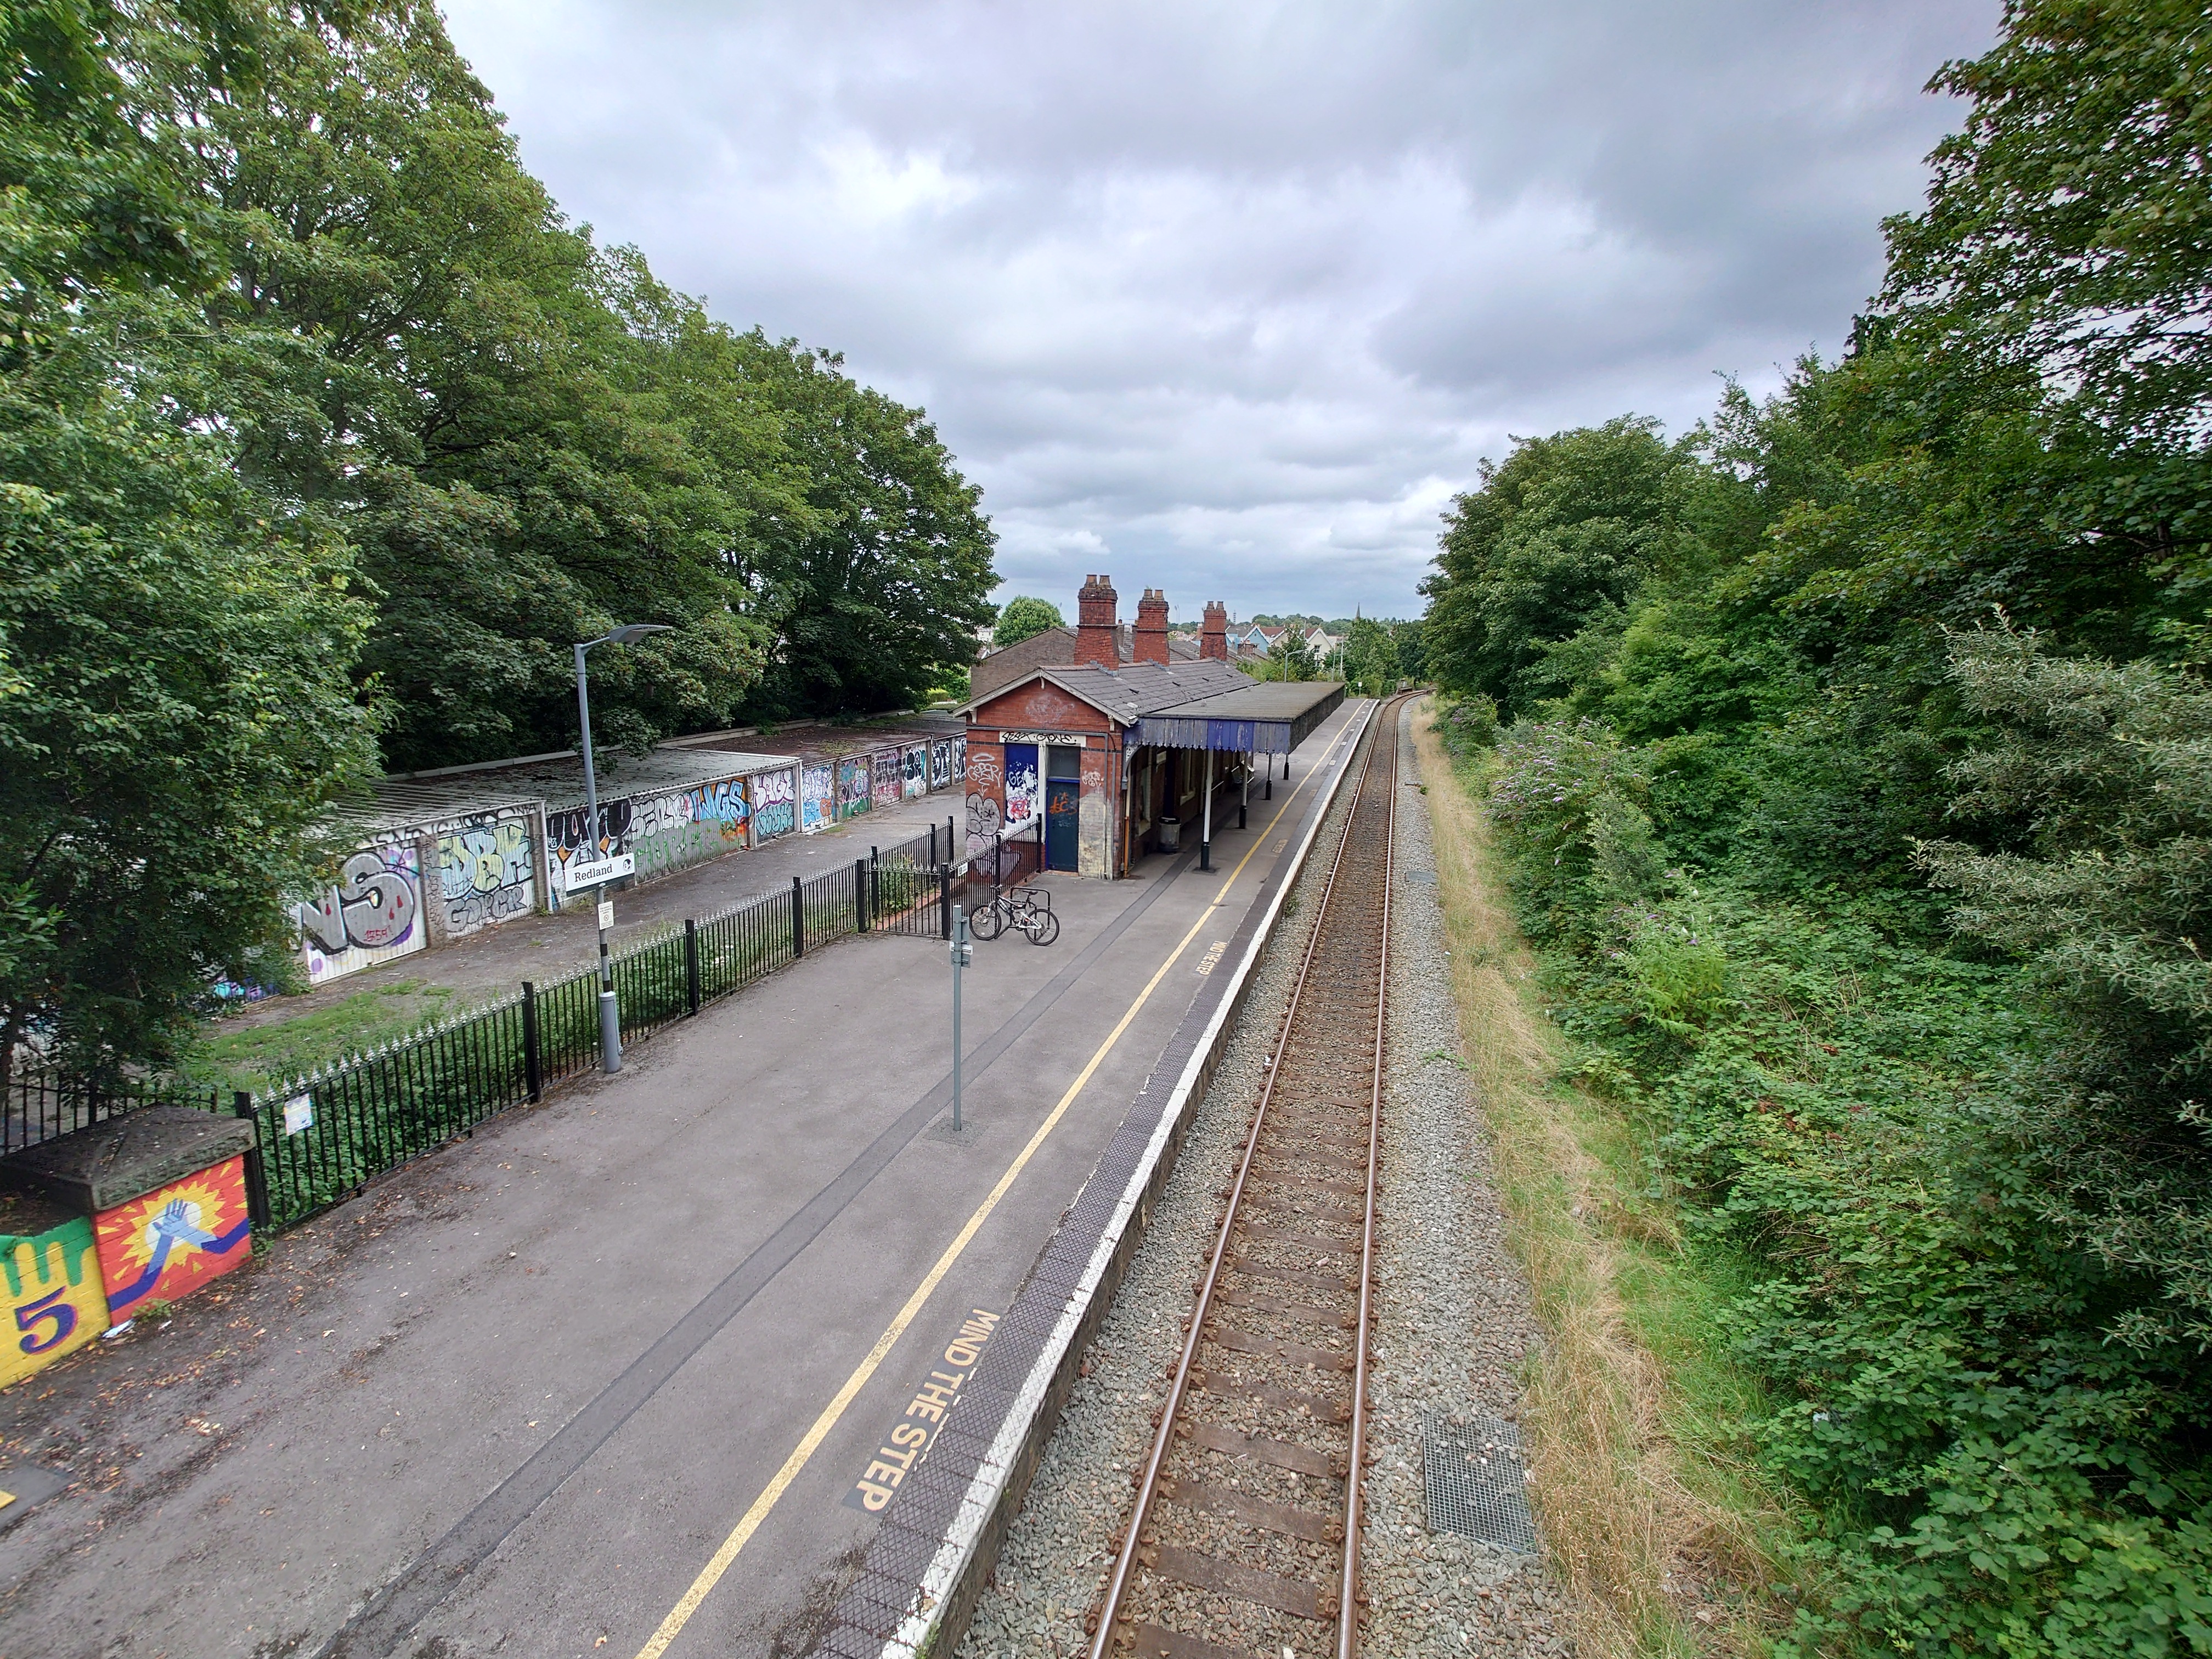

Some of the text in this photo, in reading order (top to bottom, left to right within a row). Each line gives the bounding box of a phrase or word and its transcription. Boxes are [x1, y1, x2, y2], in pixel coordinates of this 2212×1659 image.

[574, 864, 613, 883] Redland
[1203, 952, 1221, 963] THE
[1195, 961, 1215, 975] STEP
[14, 1285, 78, 1356] 5
[856, 1308, 1000, 1512] MIND THE STEP
